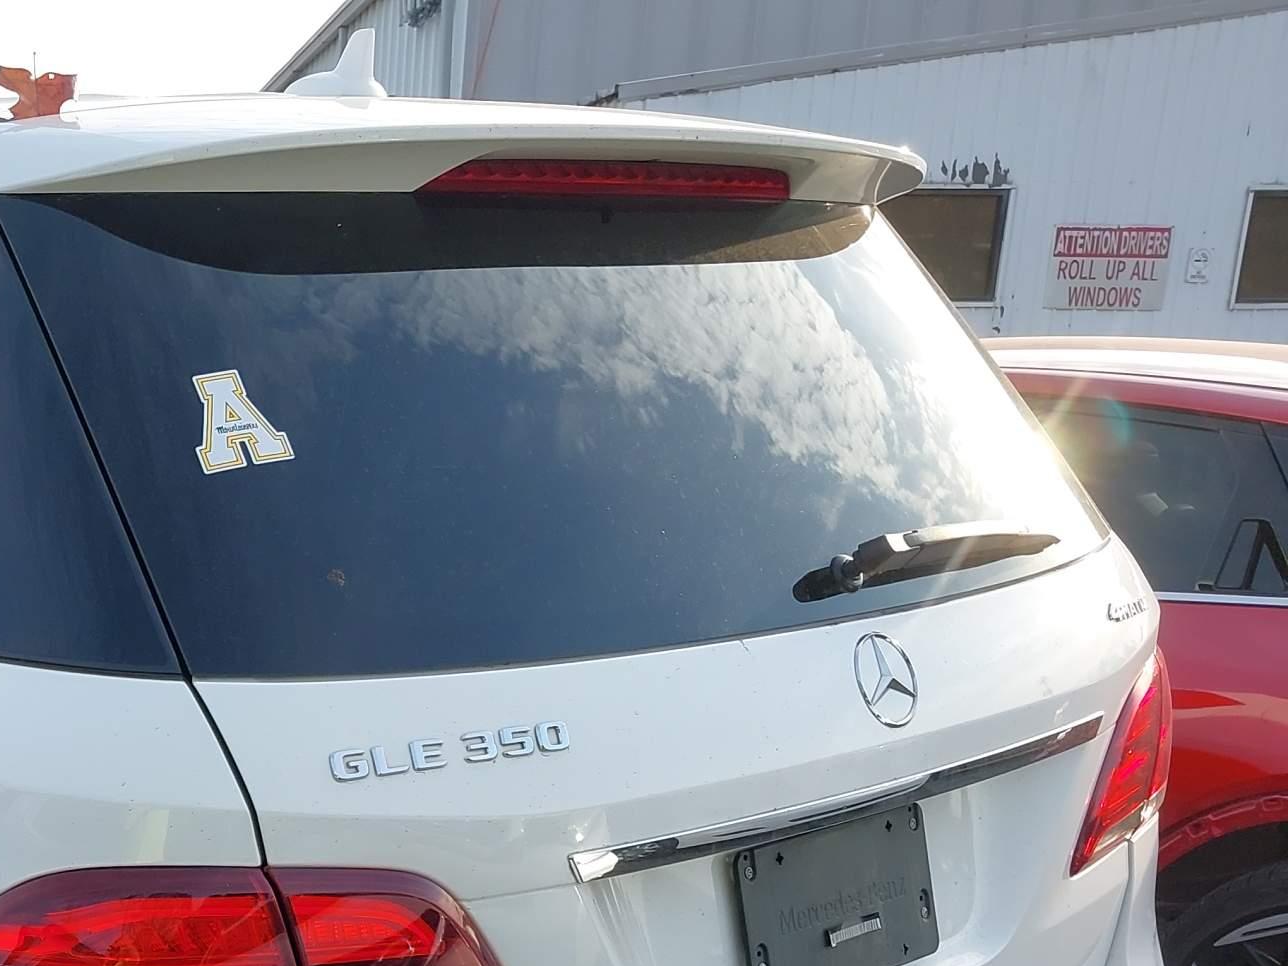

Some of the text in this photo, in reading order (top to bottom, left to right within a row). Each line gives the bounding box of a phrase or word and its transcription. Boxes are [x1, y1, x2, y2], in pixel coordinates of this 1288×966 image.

[1055, 230, 1170, 256] ATTENTION DRIVERS
[1057, 259, 1158, 281] ROLL UP ALL
[1068, 286, 1142, 308] WINDOWS
[192, 369, 295, 475] A
[329, 720, 571, 782] GLE 350
